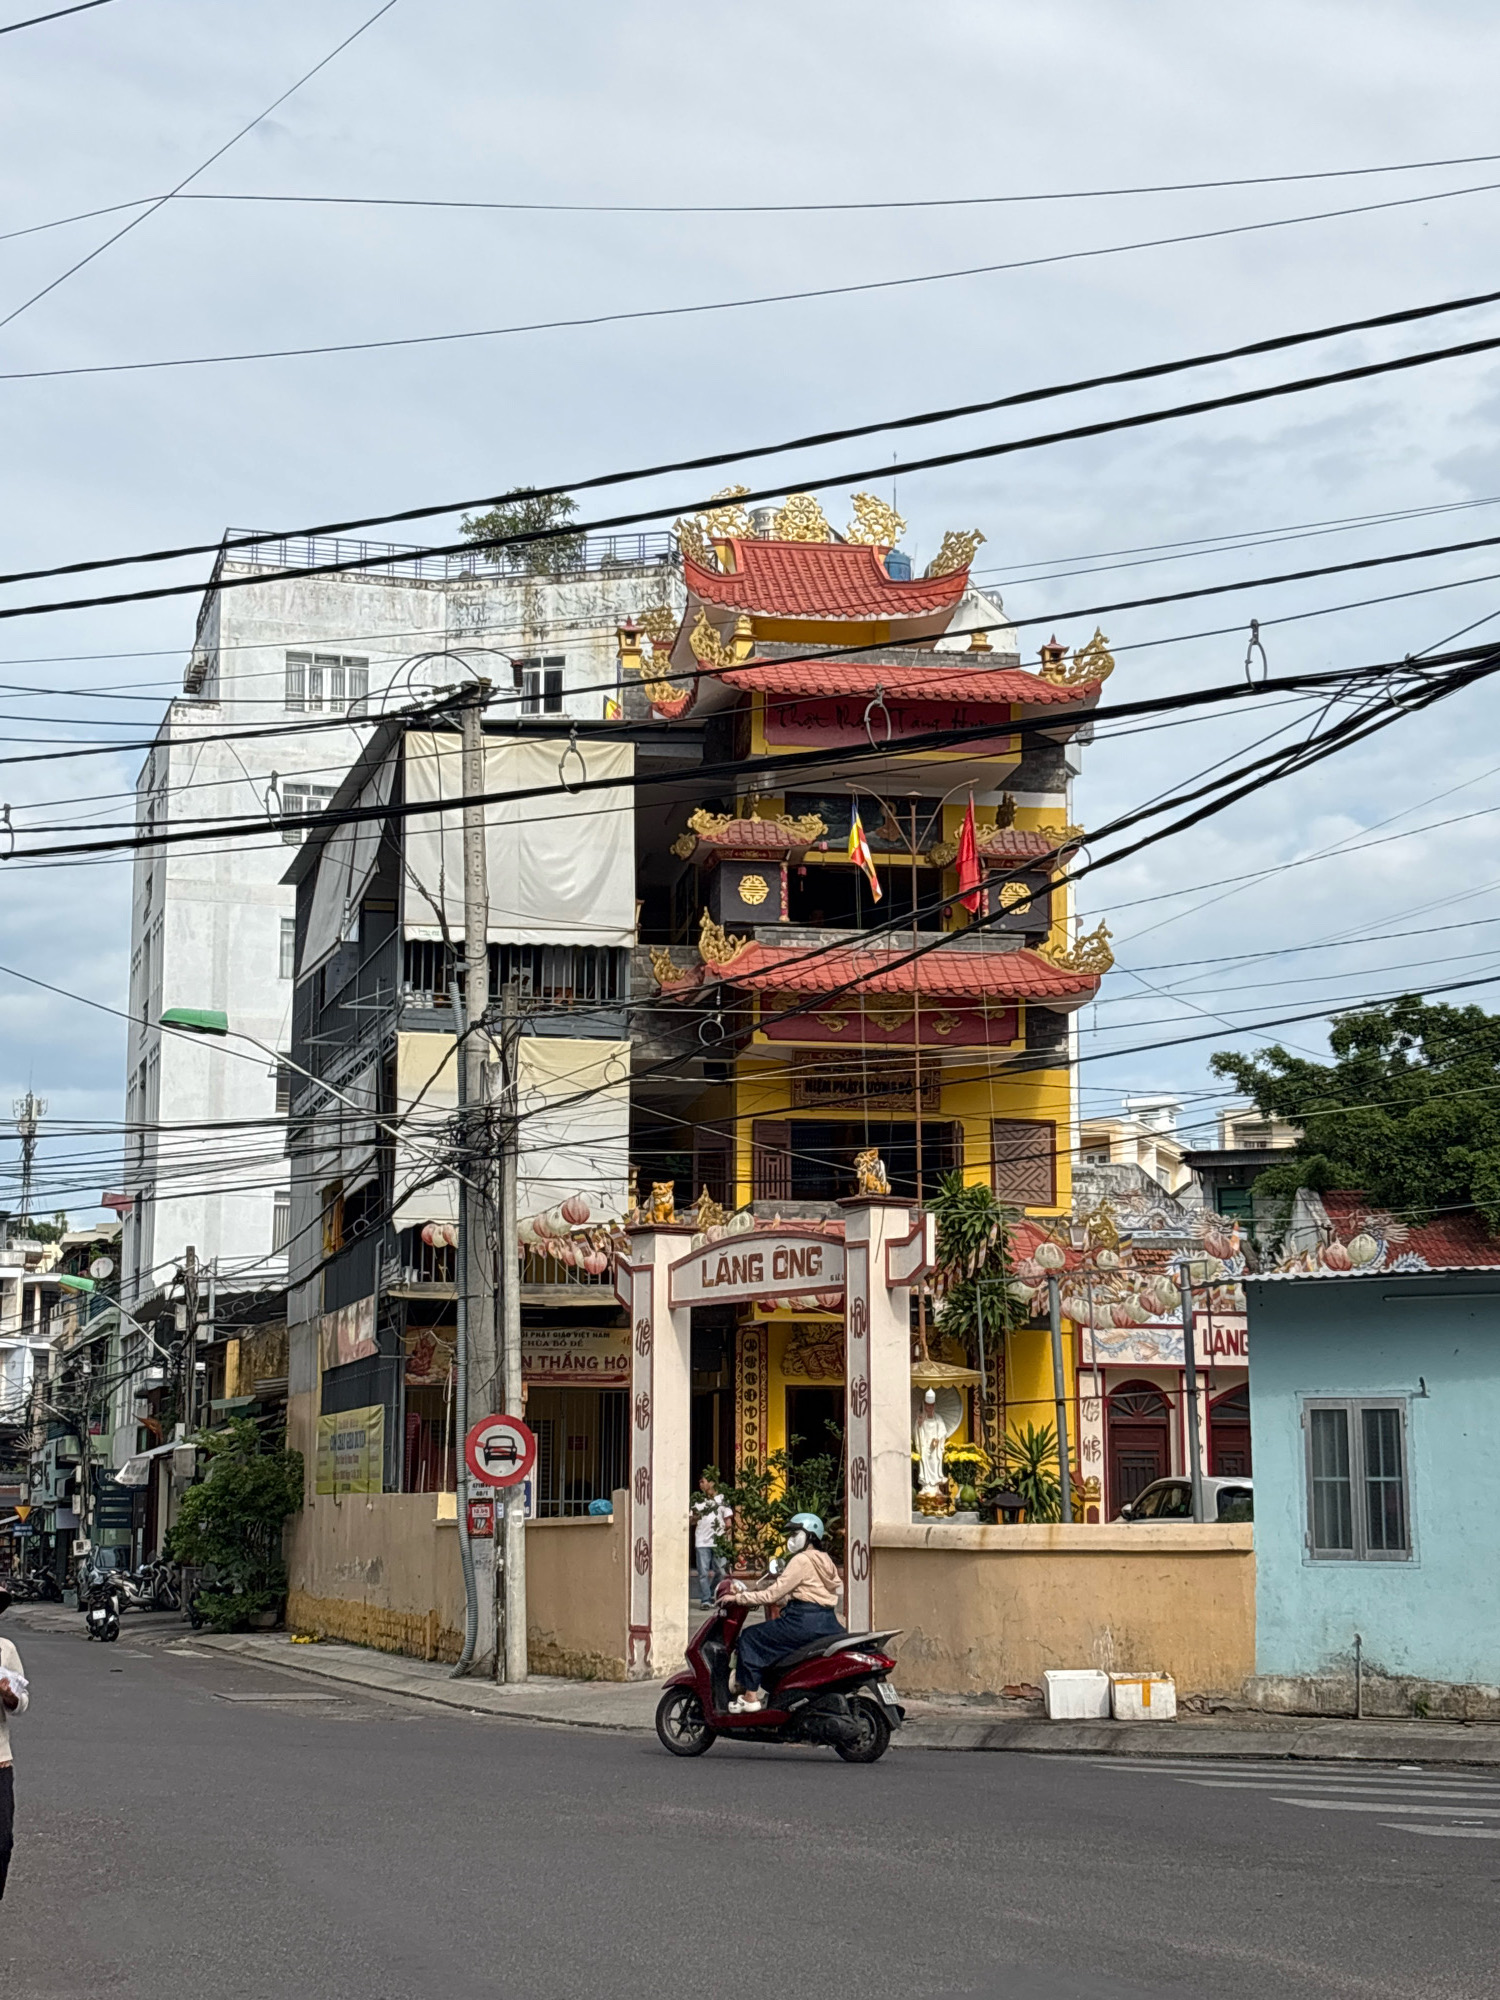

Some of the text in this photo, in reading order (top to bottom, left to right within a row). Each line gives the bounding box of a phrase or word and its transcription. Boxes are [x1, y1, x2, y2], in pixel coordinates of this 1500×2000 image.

[702, 1244, 823, 1288] LĂNG ÔNG
[531, 1330, 550, 1338] PHẬT
[573, 1331, 590, 1339] VIỆT
[538, 1350, 599, 1369] THẮNG
